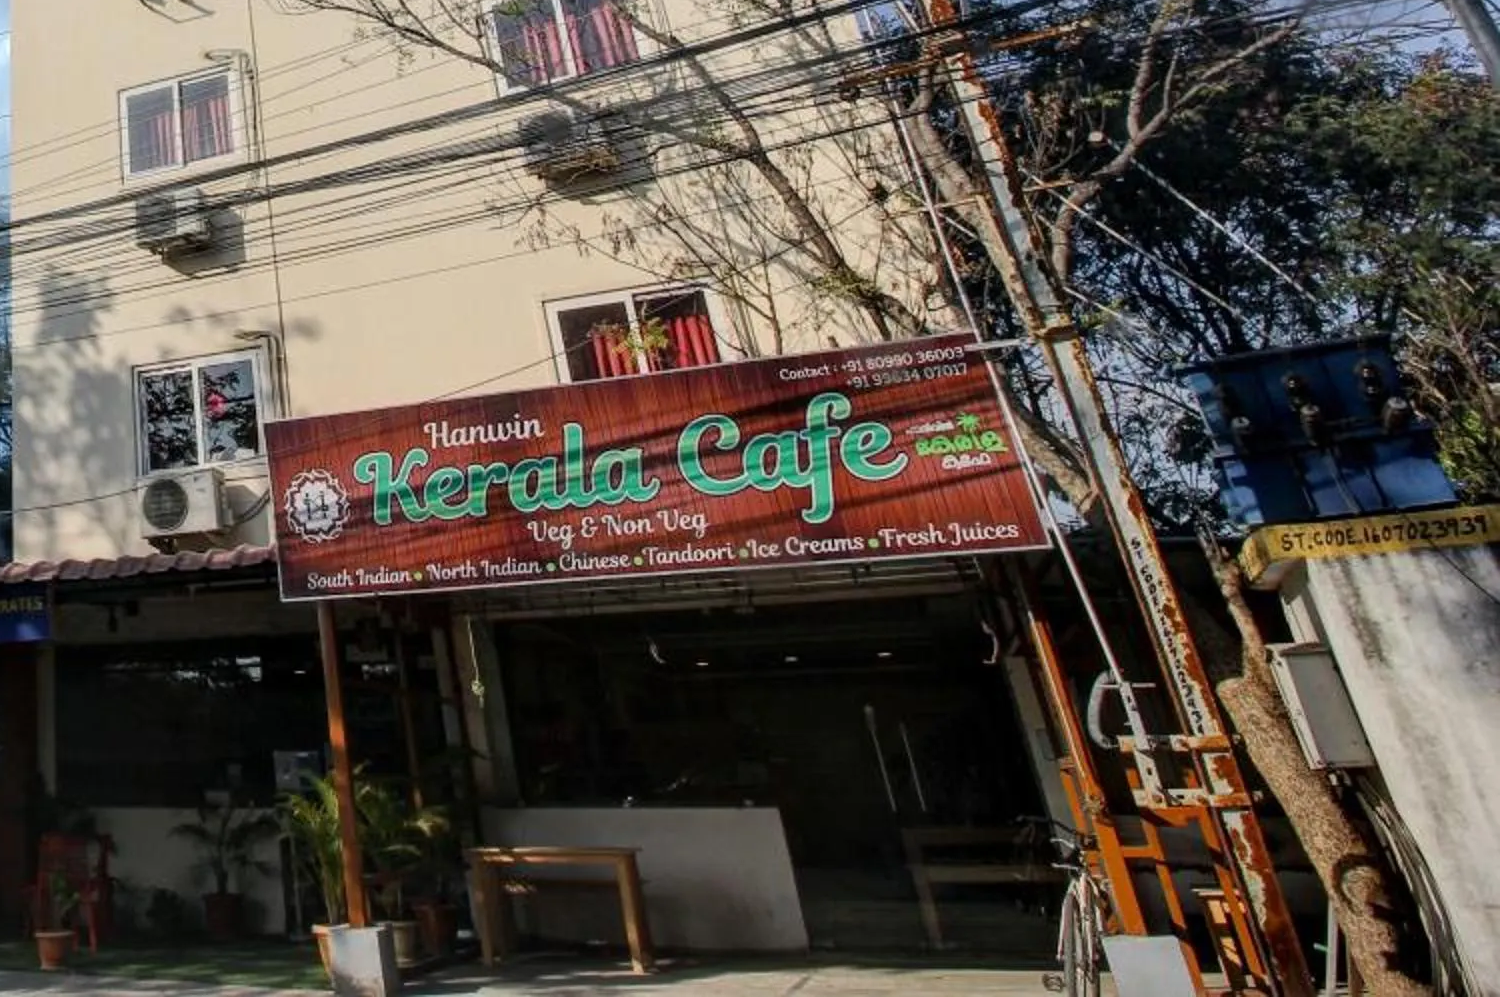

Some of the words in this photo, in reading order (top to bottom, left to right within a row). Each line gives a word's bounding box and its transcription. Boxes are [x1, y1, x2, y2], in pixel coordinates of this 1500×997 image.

[779, 364, 830, 381] Contact
[840, 360, 864, 373] +91
[915, 346, 965, 362] 36003
[923, 362, 967, 380] 07017
[423, 413, 545, 449] Hanwin
[353, 421, 661, 526] Kerala
[677, 391, 910, 525] Cafe
[527, 517, 575, 550] Veg
[580, 515, 598, 539] &
[602, 512, 655, 537] Non
[656, 509, 710, 540] Veg
[307, 571, 353, 591] South
[355, 567, 411, 587] Indian
[425, 562, 478, 582] North
[479, 557, 541, 578] Indian
[559, 552, 631, 572] Chinese
[641, 543, 736, 565] Tandoori
[745, 540, 780, 560] Ice
[785, 533, 864, 555] Creams
[877, 525, 947, 549] Fresh
[948, 521, 1020, 548] Juices
